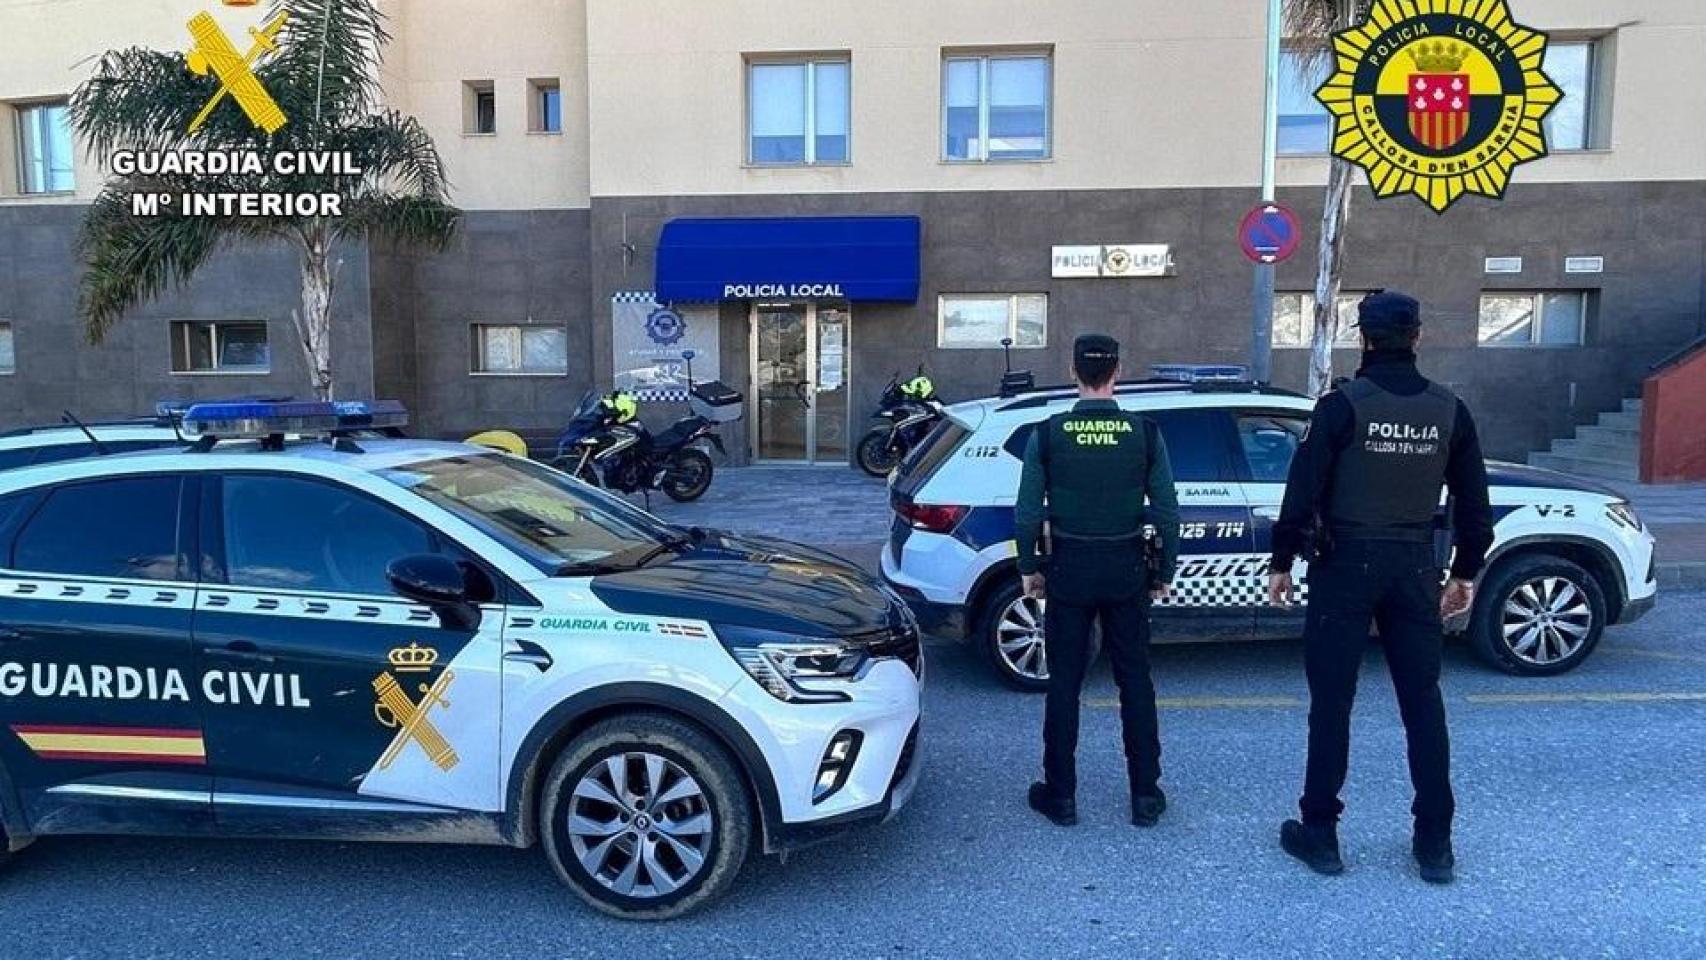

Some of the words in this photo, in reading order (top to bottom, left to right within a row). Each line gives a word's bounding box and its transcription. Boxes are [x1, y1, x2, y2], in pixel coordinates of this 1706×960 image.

[724, 284, 786, 298] POLICIA
[790, 283, 844, 297] LOCAL
[1063, 420, 1133, 433] GUARDIA
[1368, 422, 1439, 440] POLICIA
[1076, 433, 1119, 446] CIVIL
[1534, 504, 1576, 518] V-2
[1216, 521, 1245, 538] 714
[539, 617, 609, 630] GUARDIA
[613, 619, 651, 632] CIVIL
[0, 662, 191, 701] GUARDIA
[202, 669, 310, 707] CIVIL
